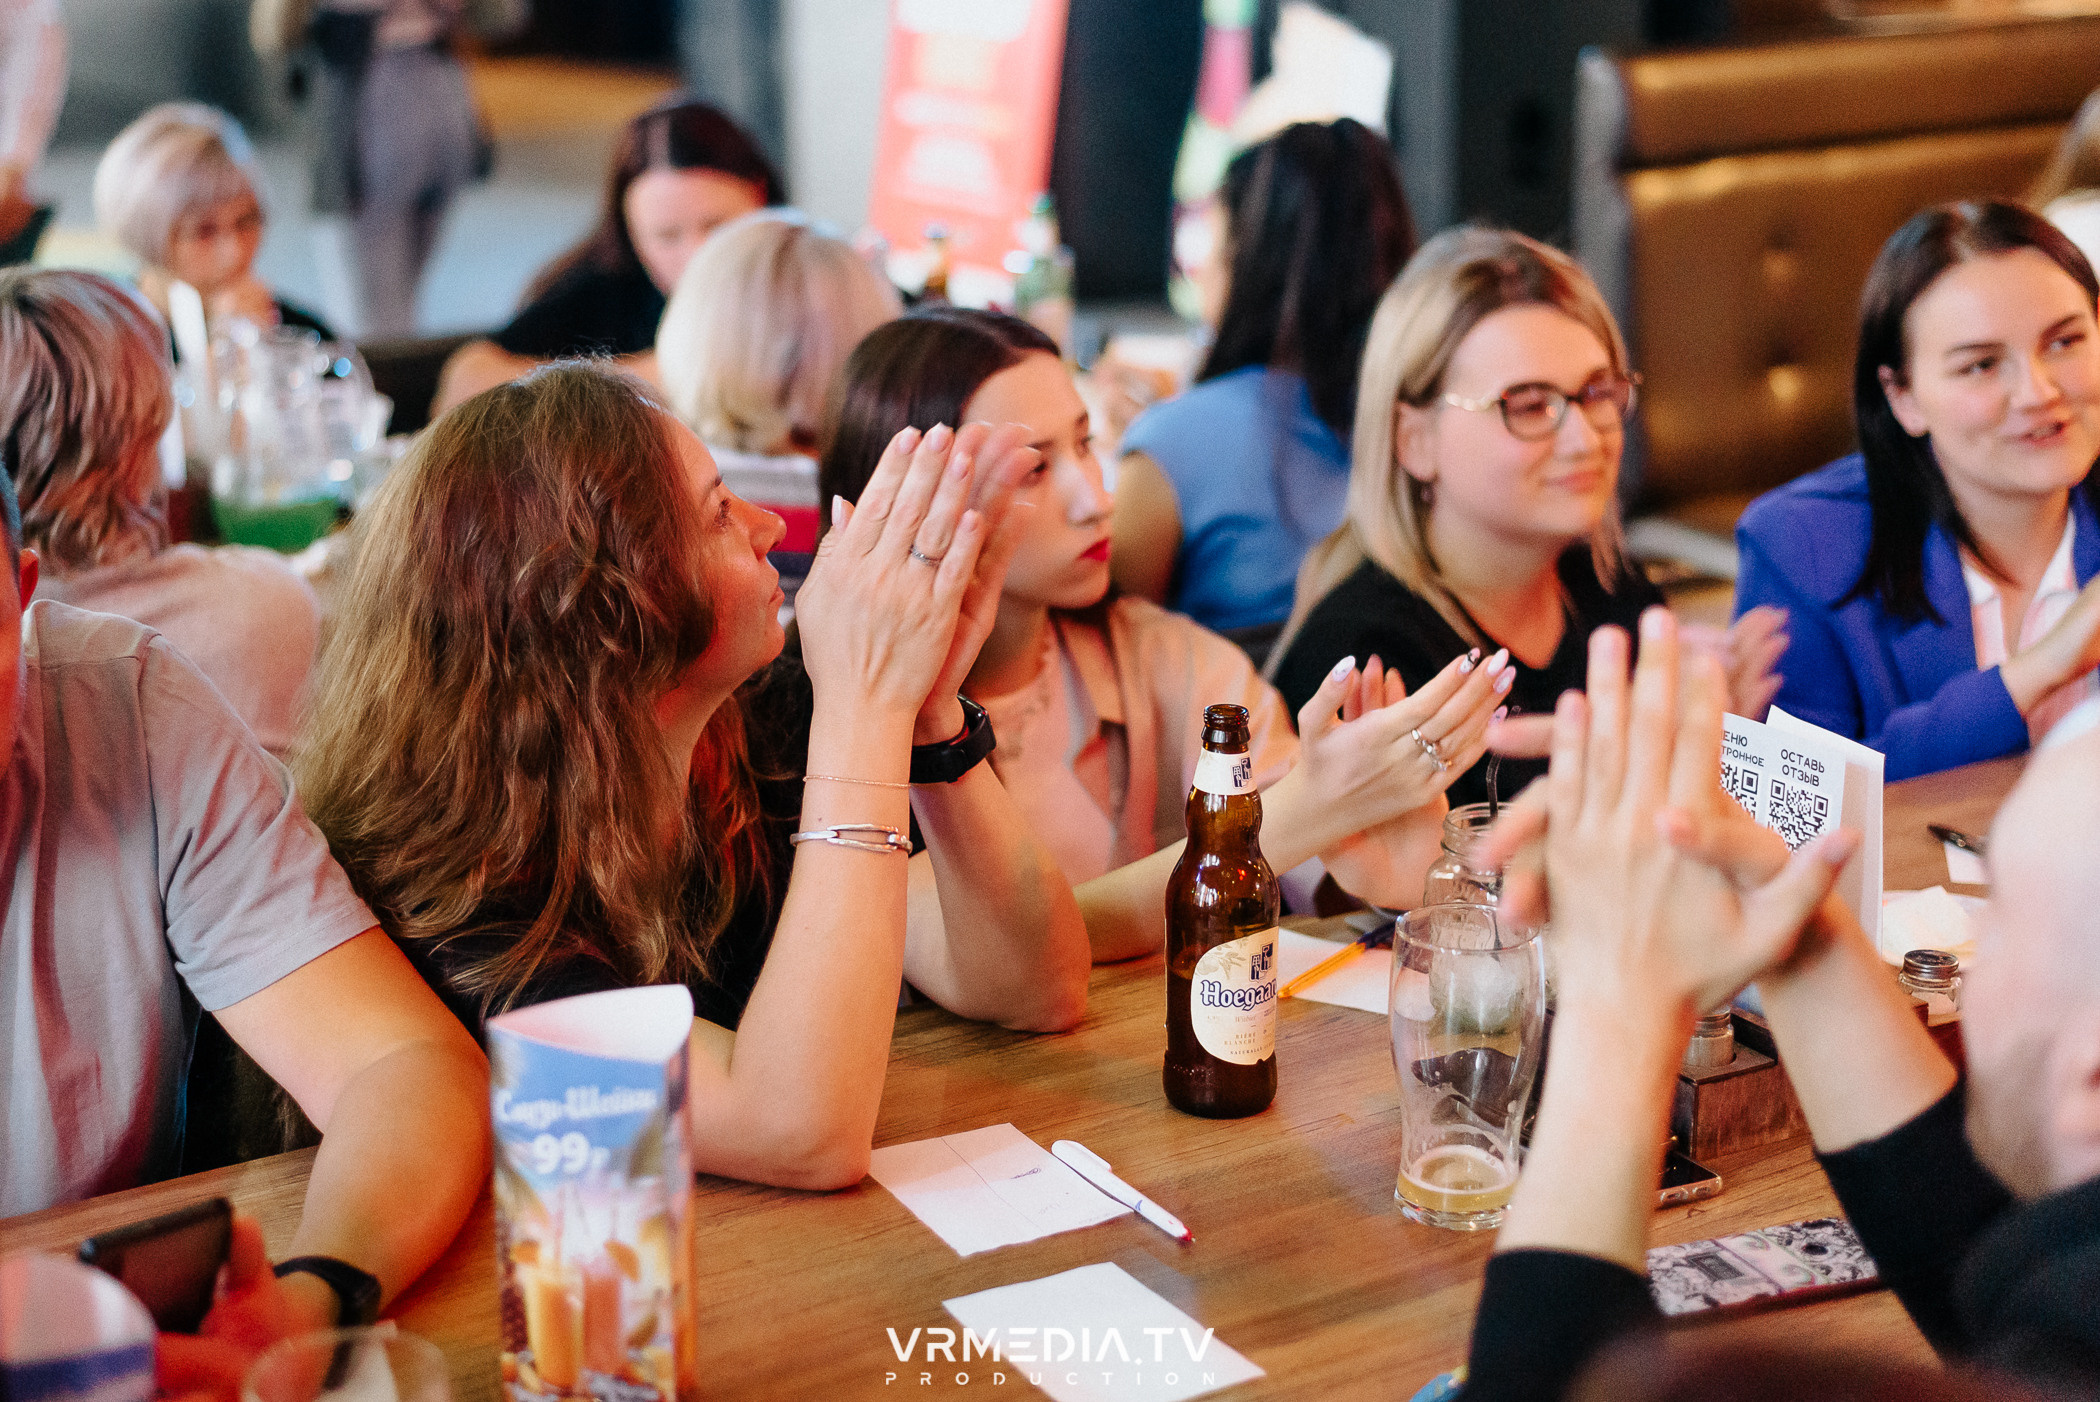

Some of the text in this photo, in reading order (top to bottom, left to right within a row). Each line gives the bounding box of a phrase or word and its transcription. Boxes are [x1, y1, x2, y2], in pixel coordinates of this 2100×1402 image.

[1722, 730, 1748, 747] ЕНЮ
[1721, 745, 1765, 768] ТРОННОЕ
[1780, 748, 1825, 773] ОСТАВЬ
[1781, 764, 1820, 787] ОТЗЫВ
[1200, 978, 1277, 1011] Hoegaar
